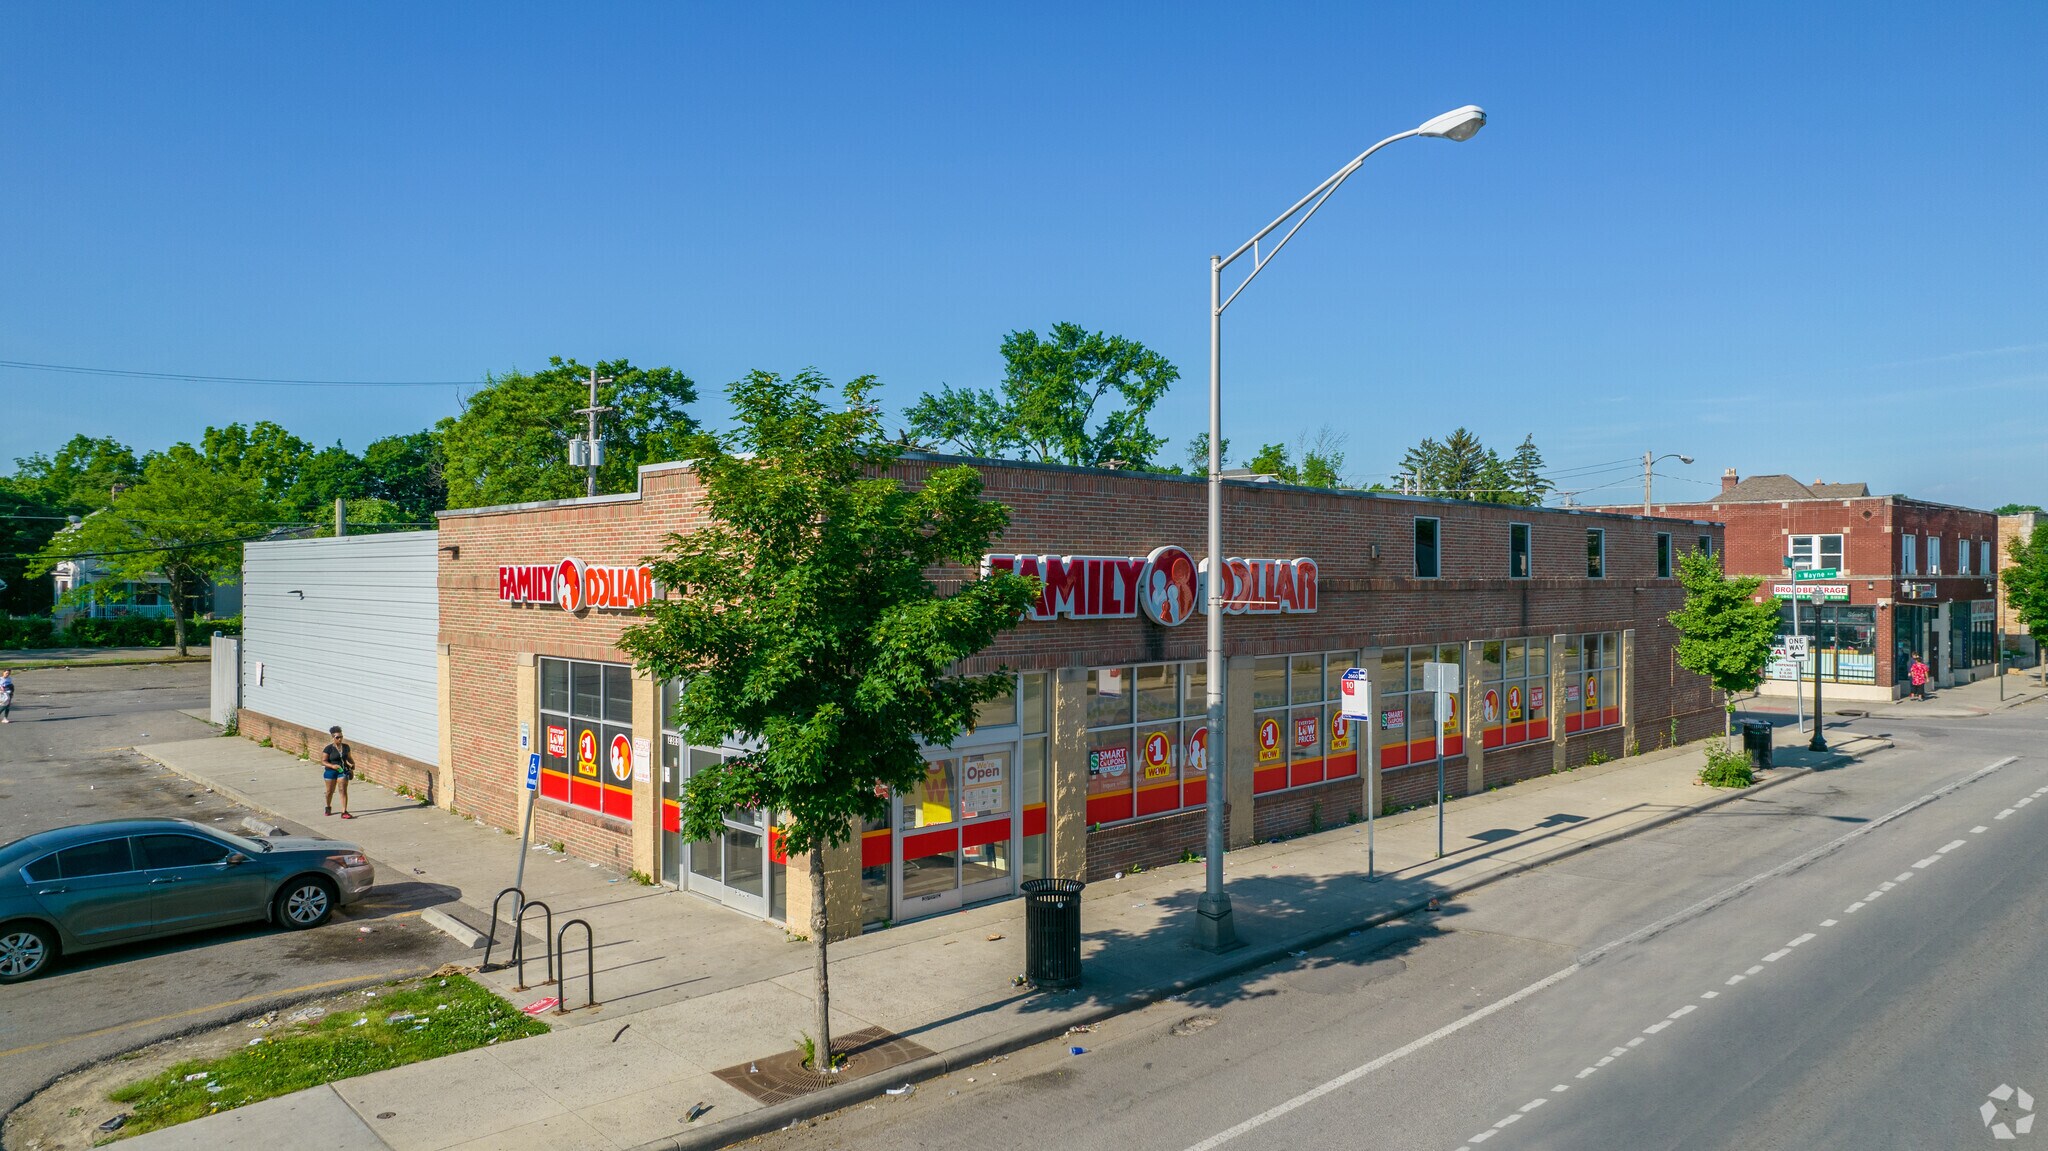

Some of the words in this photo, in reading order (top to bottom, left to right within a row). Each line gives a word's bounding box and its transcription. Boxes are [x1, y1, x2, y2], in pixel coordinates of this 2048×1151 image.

[1803, 571, 1825, 579] Wayne
[499, 566, 555, 602] FAMILY
[585, 567, 652, 608] DOLLAR
[991, 557, 1145, 617] AMILY
[1788, 637, 1804, 645] ONE
[1346, 681, 1354, 690] 10
[1387, 710, 1404, 718] SMART
[1298, 724, 1315, 736] LOW
[1334, 716, 1345, 736] $1
[549, 732, 565, 746] LOW
[1262, 723, 1275, 746] $1
[1298, 734, 1316, 743] PRICES
[549, 744, 565, 754] PRICES
[582, 735, 593, 760] $1
[1148, 736, 1164, 762] $1
[1099, 748, 1126, 760] SMART
[976, 761, 995, 769] We're
[1099, 758, 1126, 767] COUPONS
[581, 764, 595, 774] WOW
[967, 766, 1000, 782] Open
[1147, 766, 1167, 777] WOW
